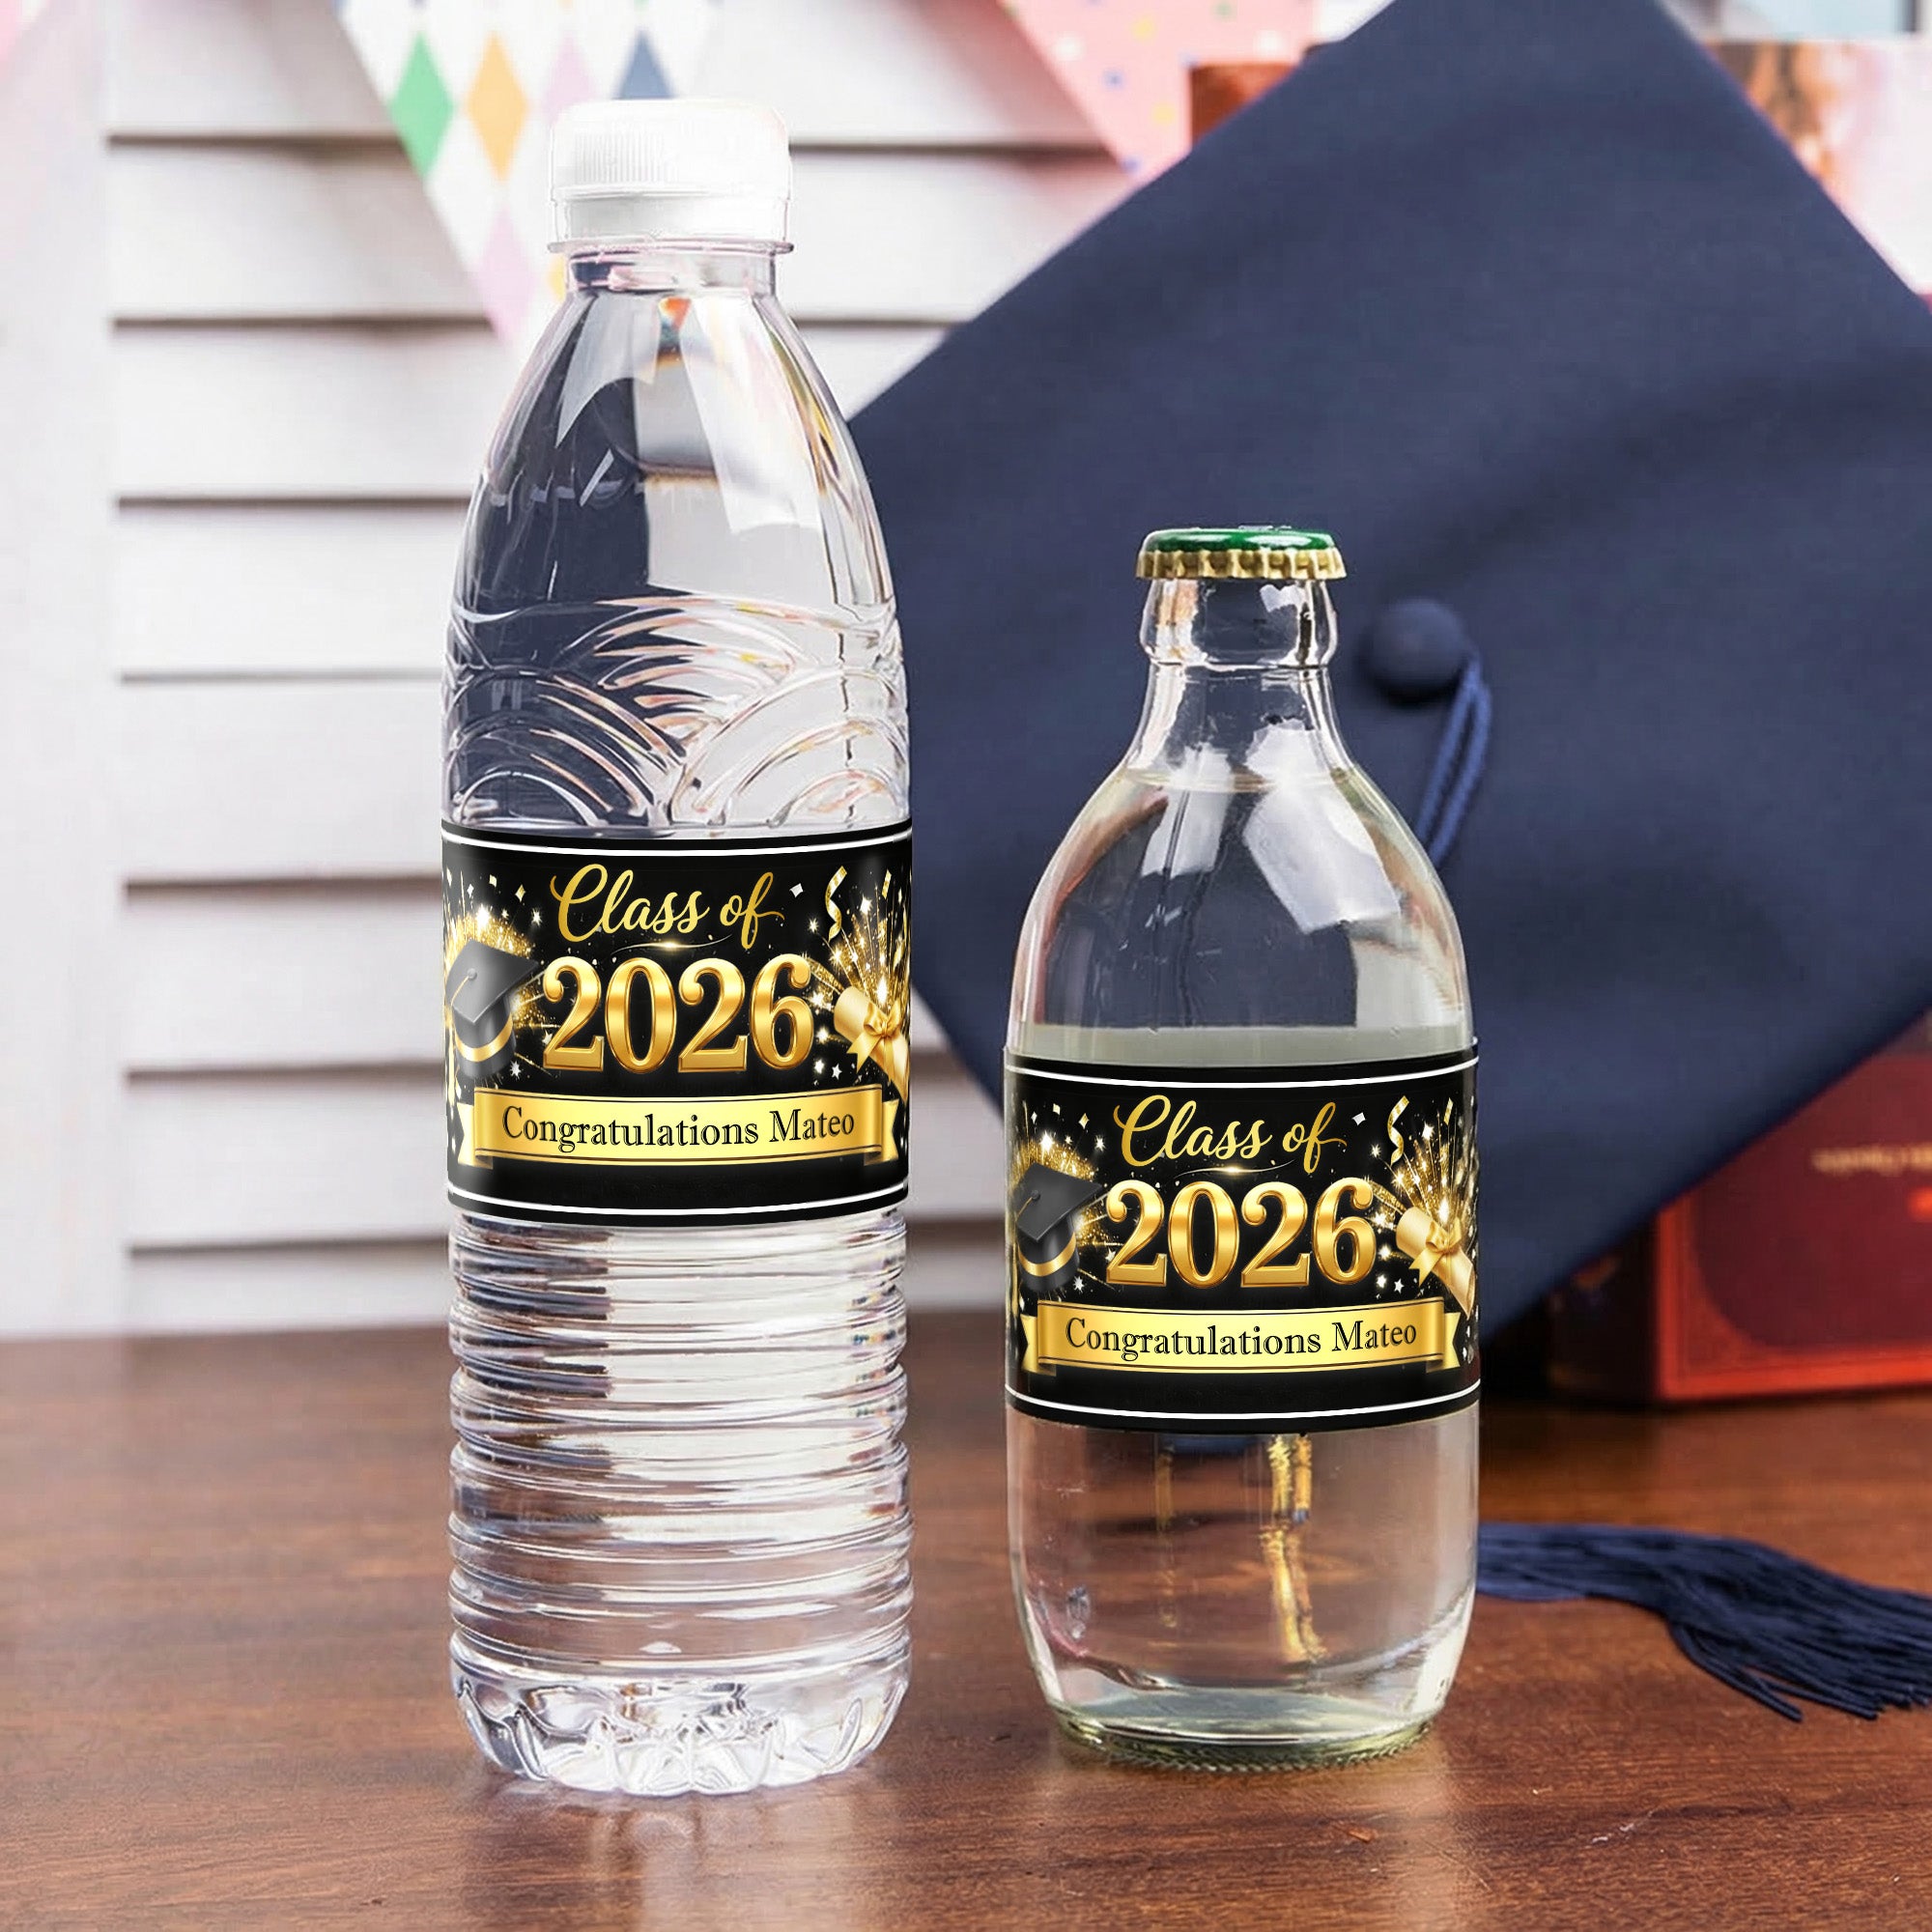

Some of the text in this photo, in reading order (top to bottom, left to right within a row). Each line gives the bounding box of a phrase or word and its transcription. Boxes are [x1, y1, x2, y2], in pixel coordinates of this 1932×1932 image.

[550, 864, 784, 949] Class of
[543, 954, 814, 1073] 2026
[502, 1106, 855, 1152] Congratulations Mateo
[1114, 1094, 1347, 1173] Class of
[1106, 1178, 1377, 1289] 2026
[1065, 1318, 1417, 1361] Congratulations Mateo
